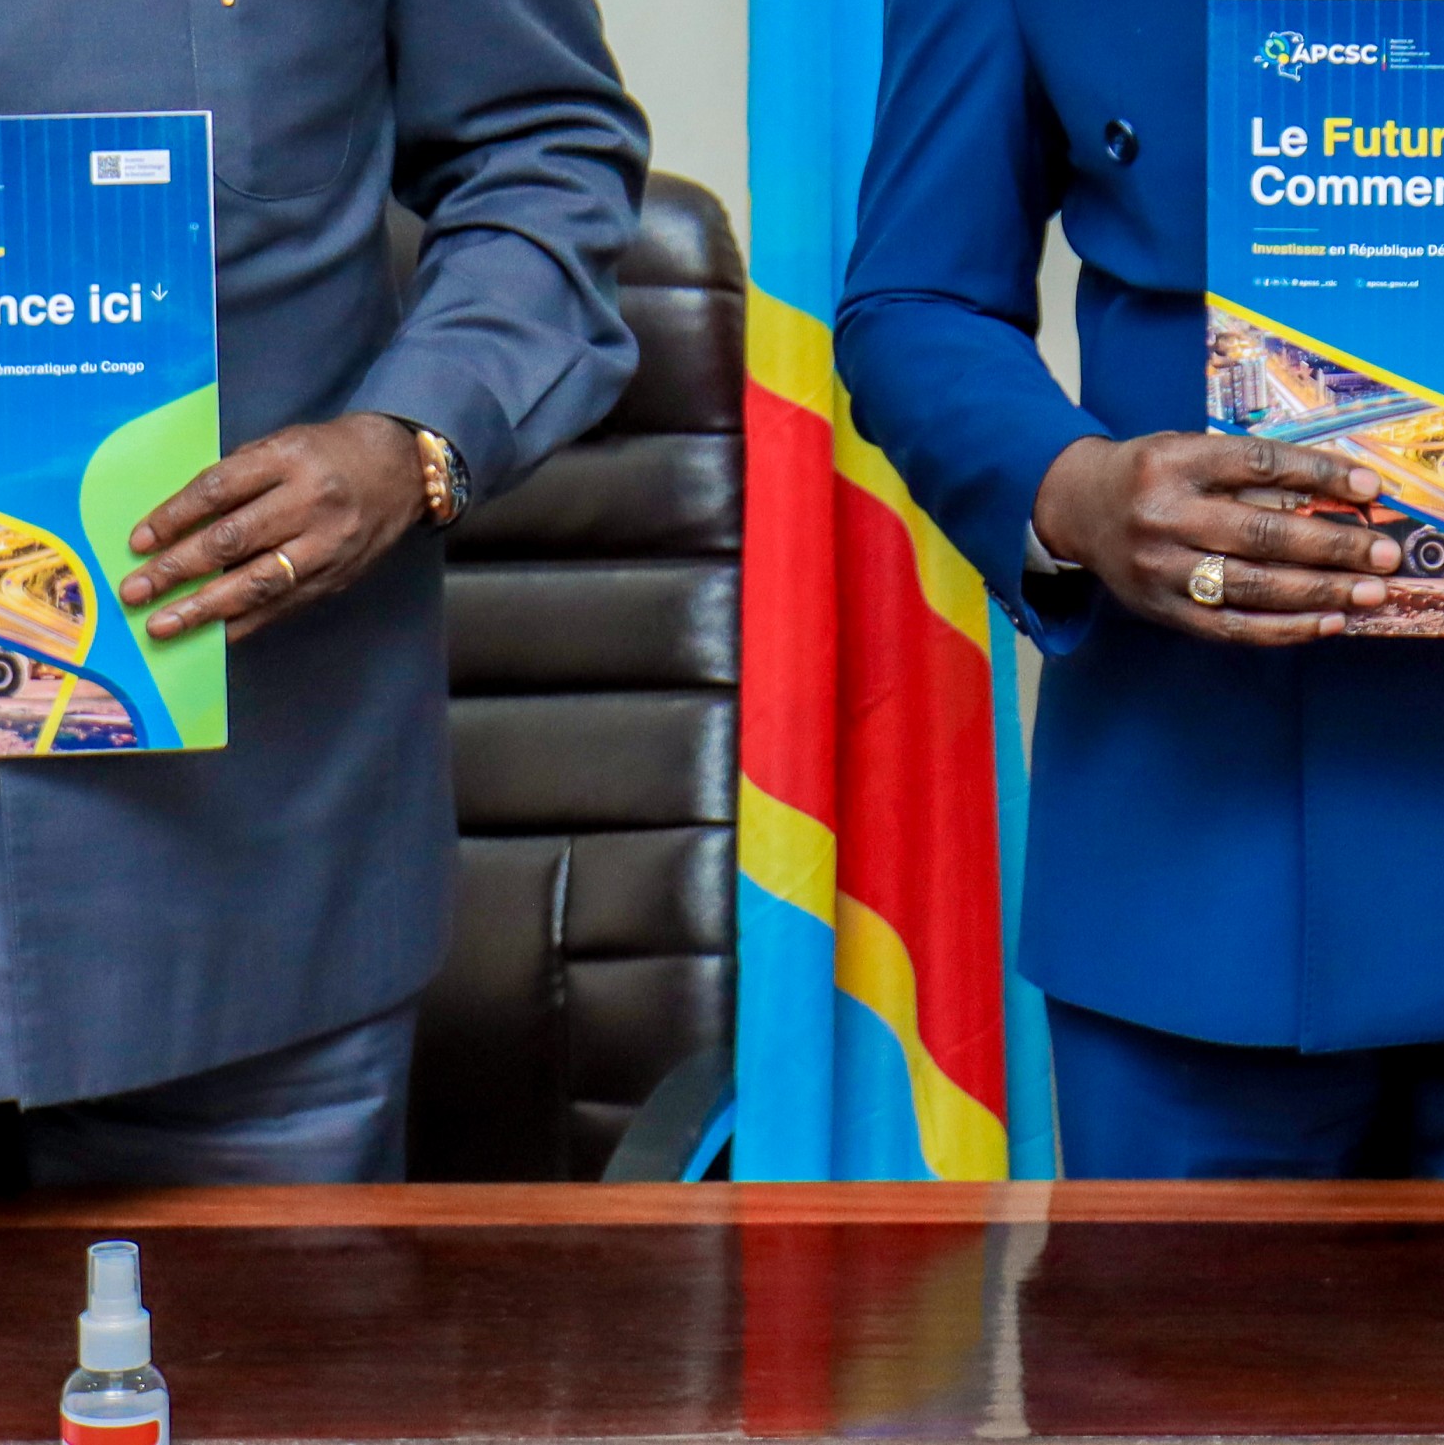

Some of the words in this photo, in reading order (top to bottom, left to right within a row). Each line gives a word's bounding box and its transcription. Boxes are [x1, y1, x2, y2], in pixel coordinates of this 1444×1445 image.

[1290, 41, 1378, 65] APCSC
[1251, 116, 1308, 157] Le
[1251, 242, 1326, 255] Investissez
[1329, 245, 1346, 255] en
[1348, 243, 1425, 258] République
[88, 283, 143, 324] ici
[80, 362, 97, 373] du
[100, 361, 145, 375] Congo
